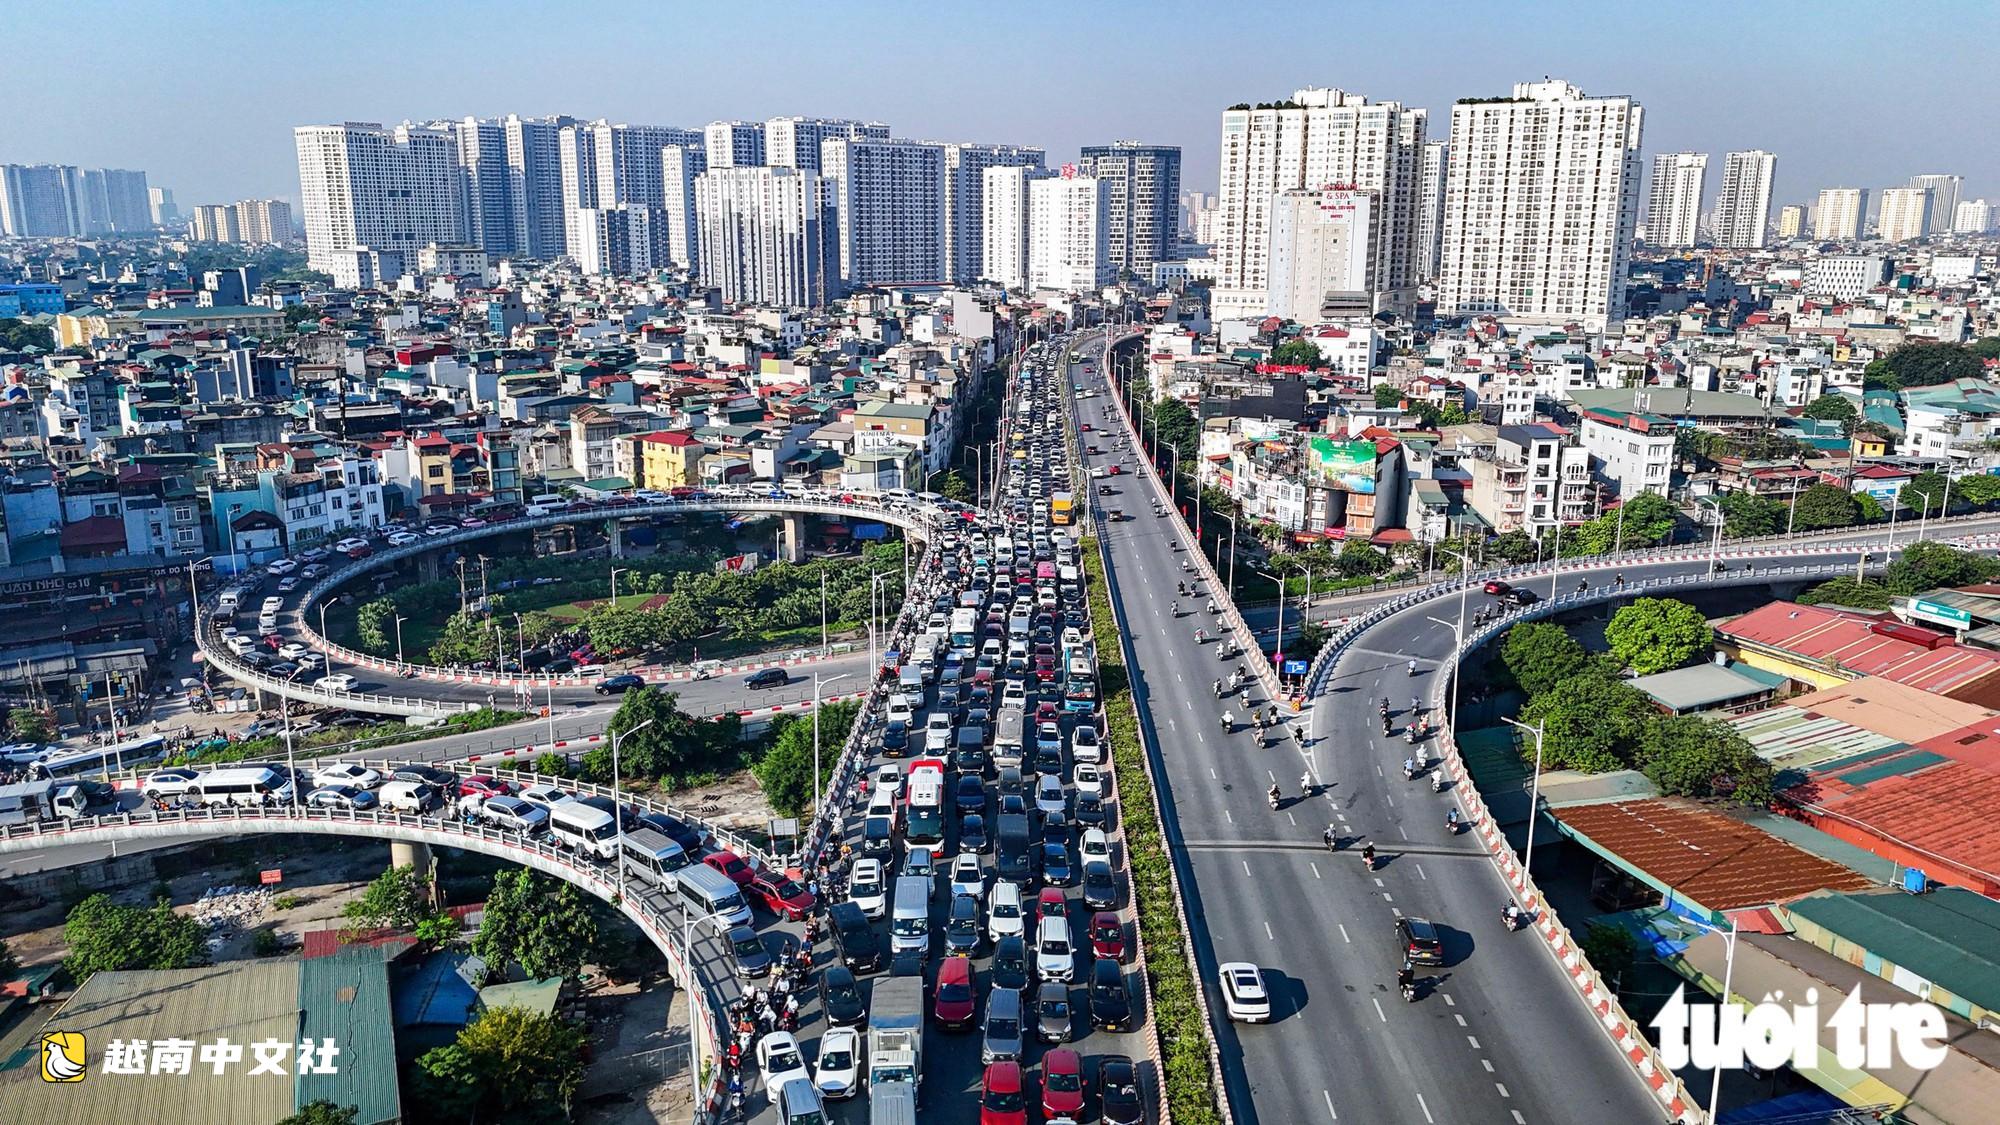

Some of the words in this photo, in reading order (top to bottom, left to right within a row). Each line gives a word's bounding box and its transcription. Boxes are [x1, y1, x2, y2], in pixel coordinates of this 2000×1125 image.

[1078, 165, 1098, 177] MB
[1335, 192, 1350, 200] SPA
[863, 437, 894, 447] LILY
[79, 578, 90, 588] 10
